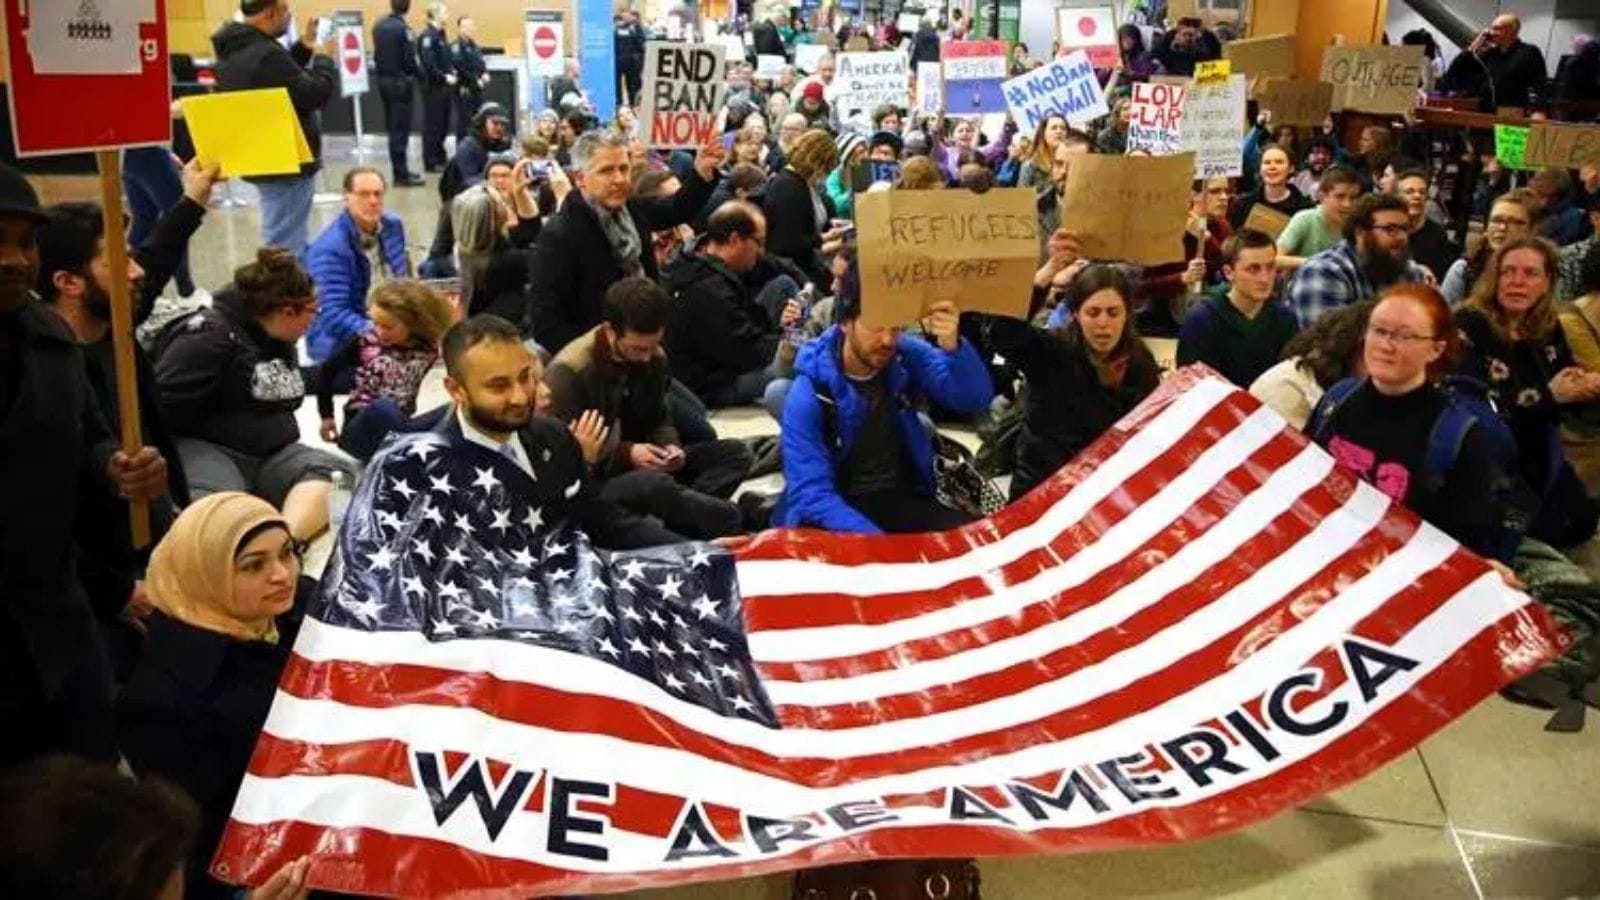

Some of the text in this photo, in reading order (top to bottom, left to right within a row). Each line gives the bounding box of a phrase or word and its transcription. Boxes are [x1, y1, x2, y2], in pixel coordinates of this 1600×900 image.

[657, 48, 716, 83] END
[654, 81, 716, 113] BAN
[1134, 85, 1185, 107] LOV
[652, 111, 717, 146] NOW
[1140, 106, 1182, 130] LAR
[889, 212, 1036, 247] REFUGEES
[883, 257, 1000, 288] WELCOME
[414, 637, 1421, 864] WE ARE AMERICA
